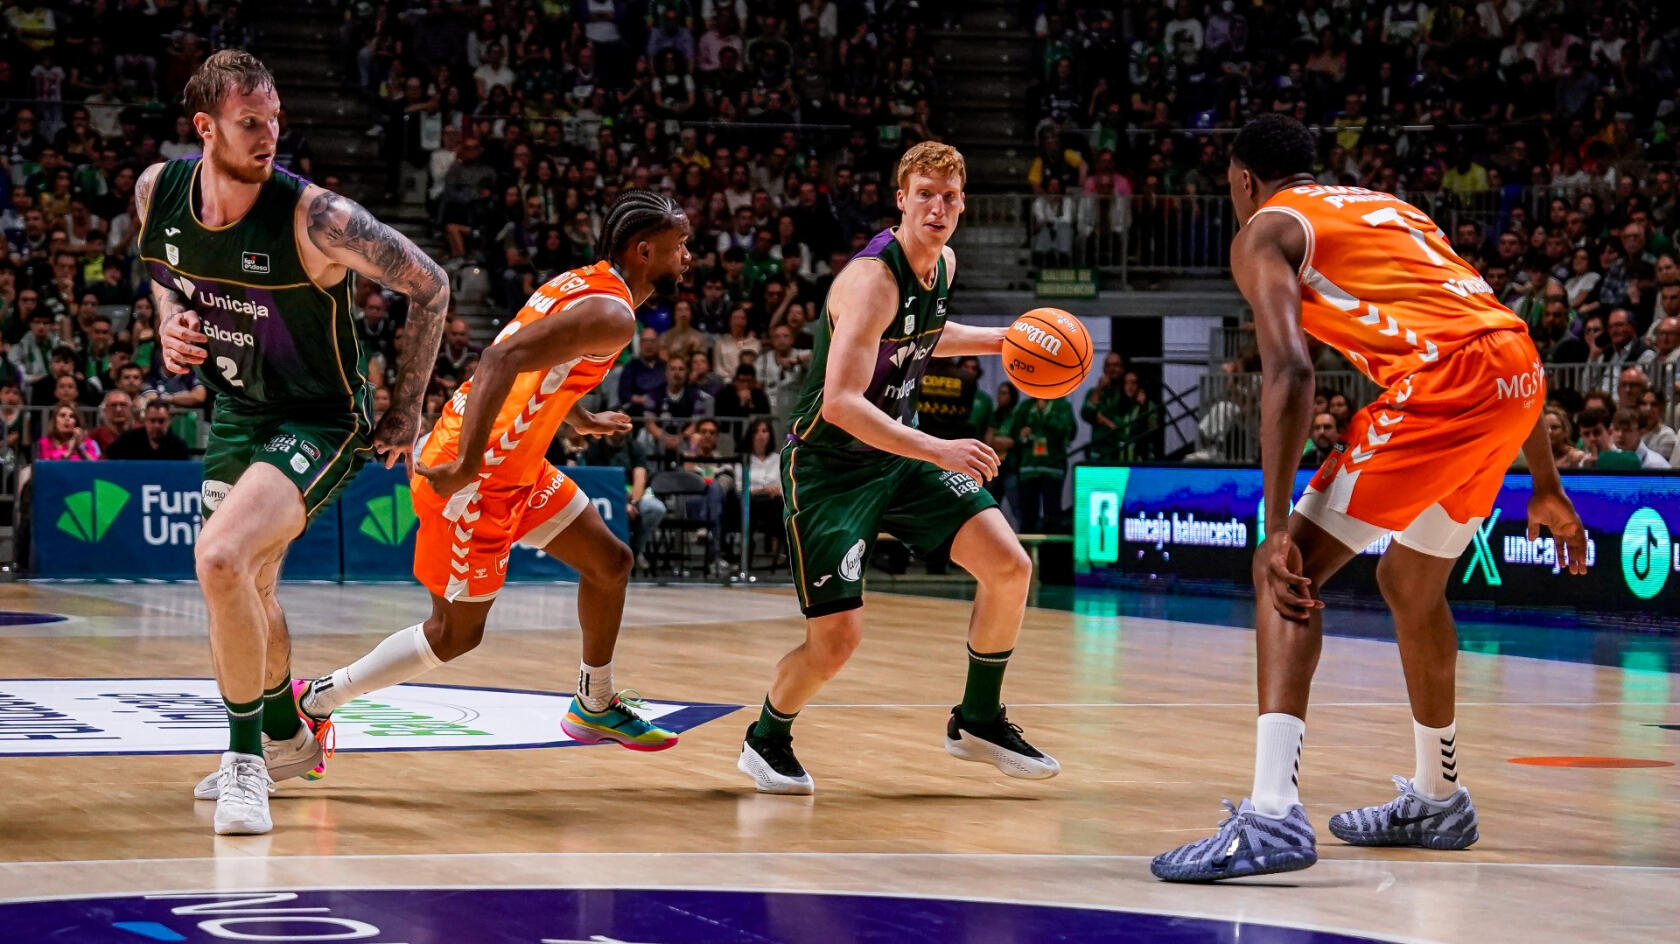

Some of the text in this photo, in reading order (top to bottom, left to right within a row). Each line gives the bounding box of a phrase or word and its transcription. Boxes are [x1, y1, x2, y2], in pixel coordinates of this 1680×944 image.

[200, 291, 269, 320] Unicaja
[203, 321, 255, 347] álaga
[1013, 321, 1062, 356] Wilson
[217, 356, 244, 387] 2
[142, 484, 202, 514] Fun
[143, 515, 201, 546] Uni
[1124, 510, 1248, 550] unicaja baloncesto
